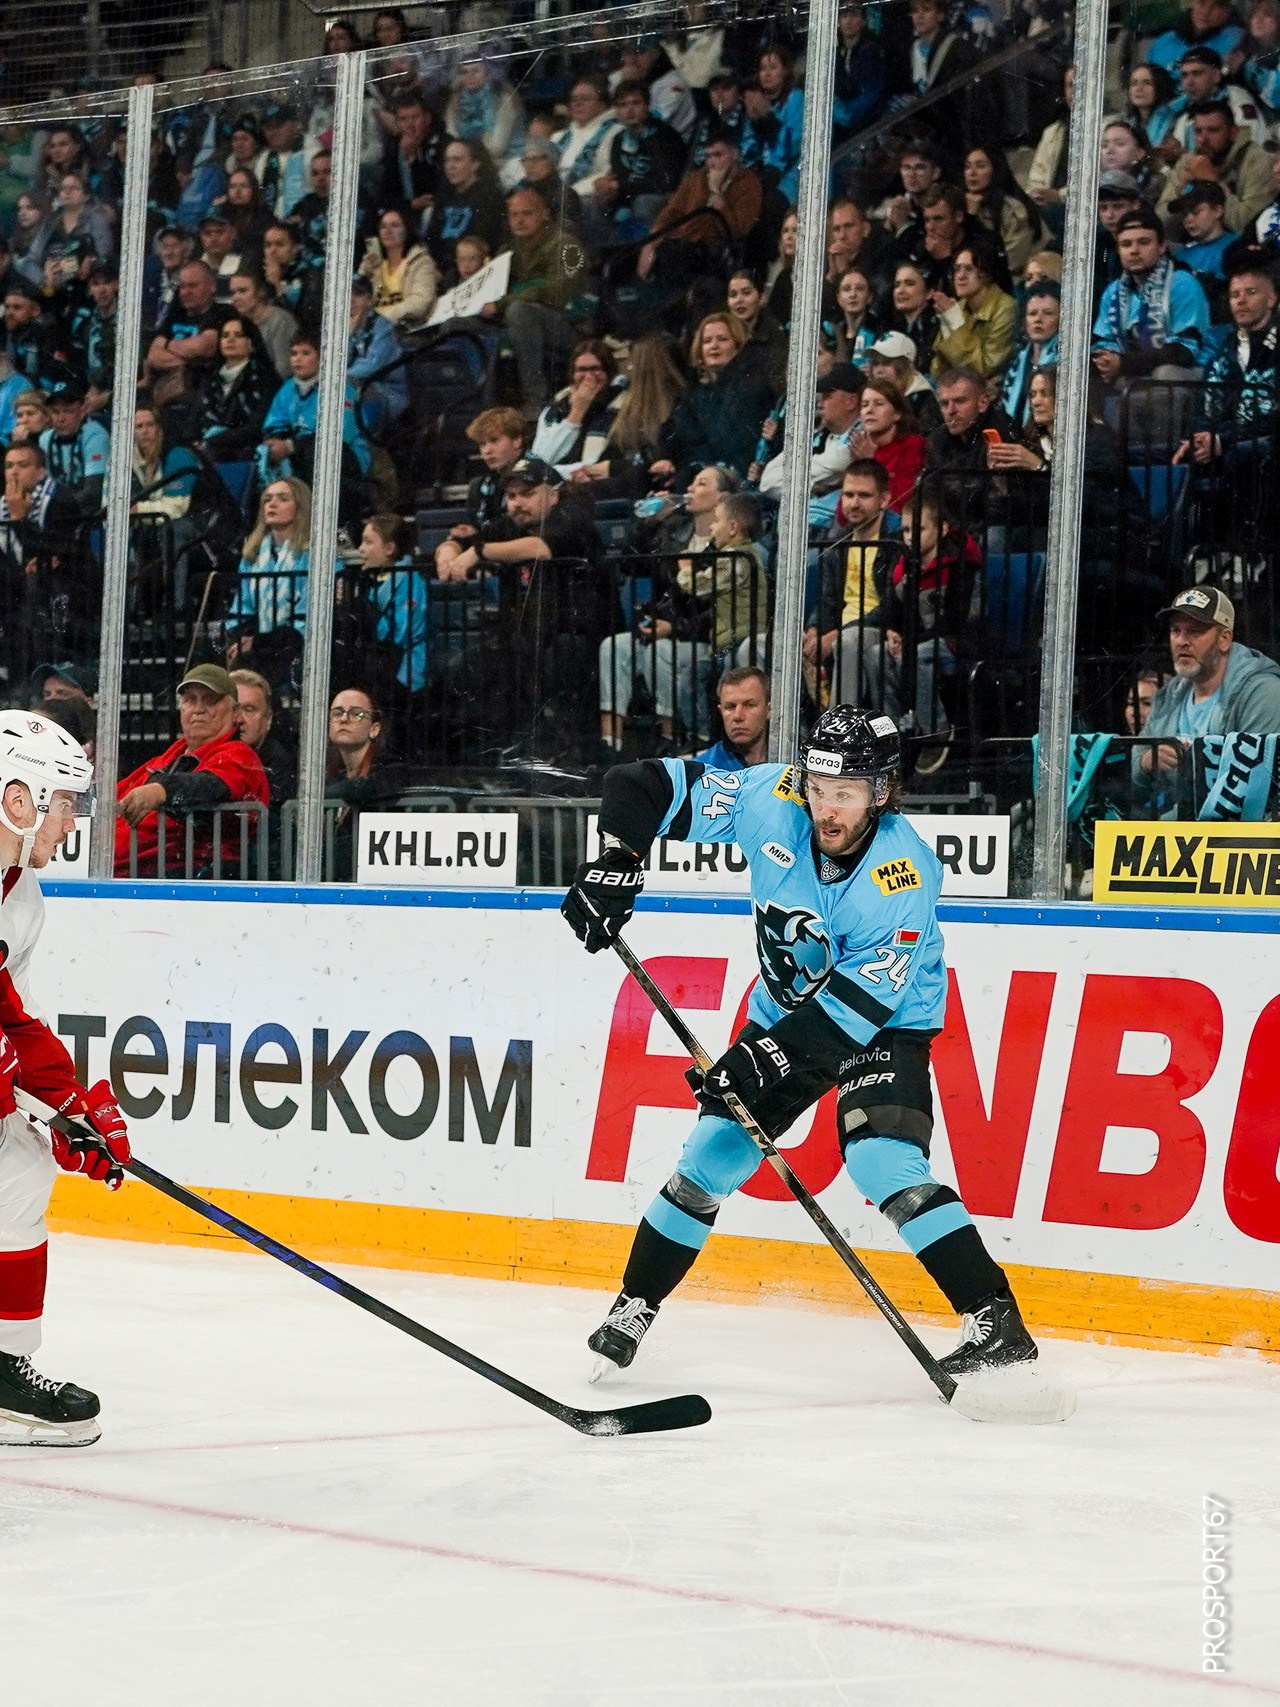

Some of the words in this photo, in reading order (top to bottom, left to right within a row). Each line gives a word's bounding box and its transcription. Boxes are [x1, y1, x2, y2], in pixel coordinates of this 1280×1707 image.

[700, 772, 741, 821] 24
[368, 831, 506, 867] KHL.RU
[768, 845, 791, 864] МИР
[877, 860, 910, 880] MAX
[887, 874, 918, 892] LINE
[857, 947, 912, 994] 24
[838, 1046, 891, 1075] Belavia
[59, 1091, 78, 1112] CCM
